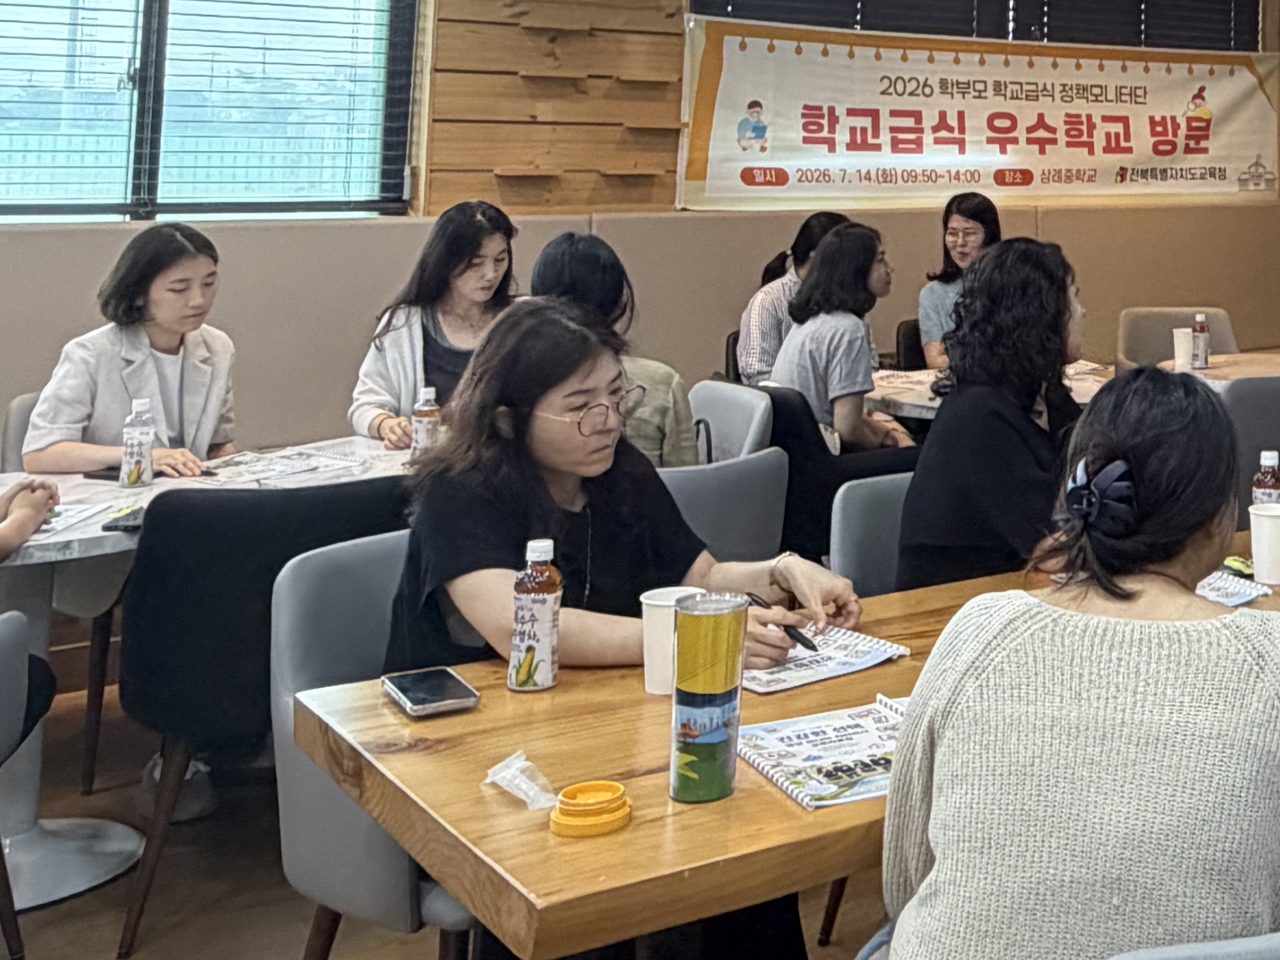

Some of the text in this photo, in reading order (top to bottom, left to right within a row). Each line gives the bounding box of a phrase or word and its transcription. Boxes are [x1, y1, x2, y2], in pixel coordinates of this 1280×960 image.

[879, 75, 1149, 106] 2026 학부모 학교급식 정책모니터단
[800, 103, 1213, 157] 학교급식 우수학교 방문
[752, 168, 776, 183] 일시
[795, 168, 836, 184] 2026.
[838, 168, 852, 184] 7.
[900, 168, 981, 184] 09:50~14:00
[1040, 168, 1098, 185] 삼례중학교
[1129, 166, 1228, 183] 전북특별자치도교육청
